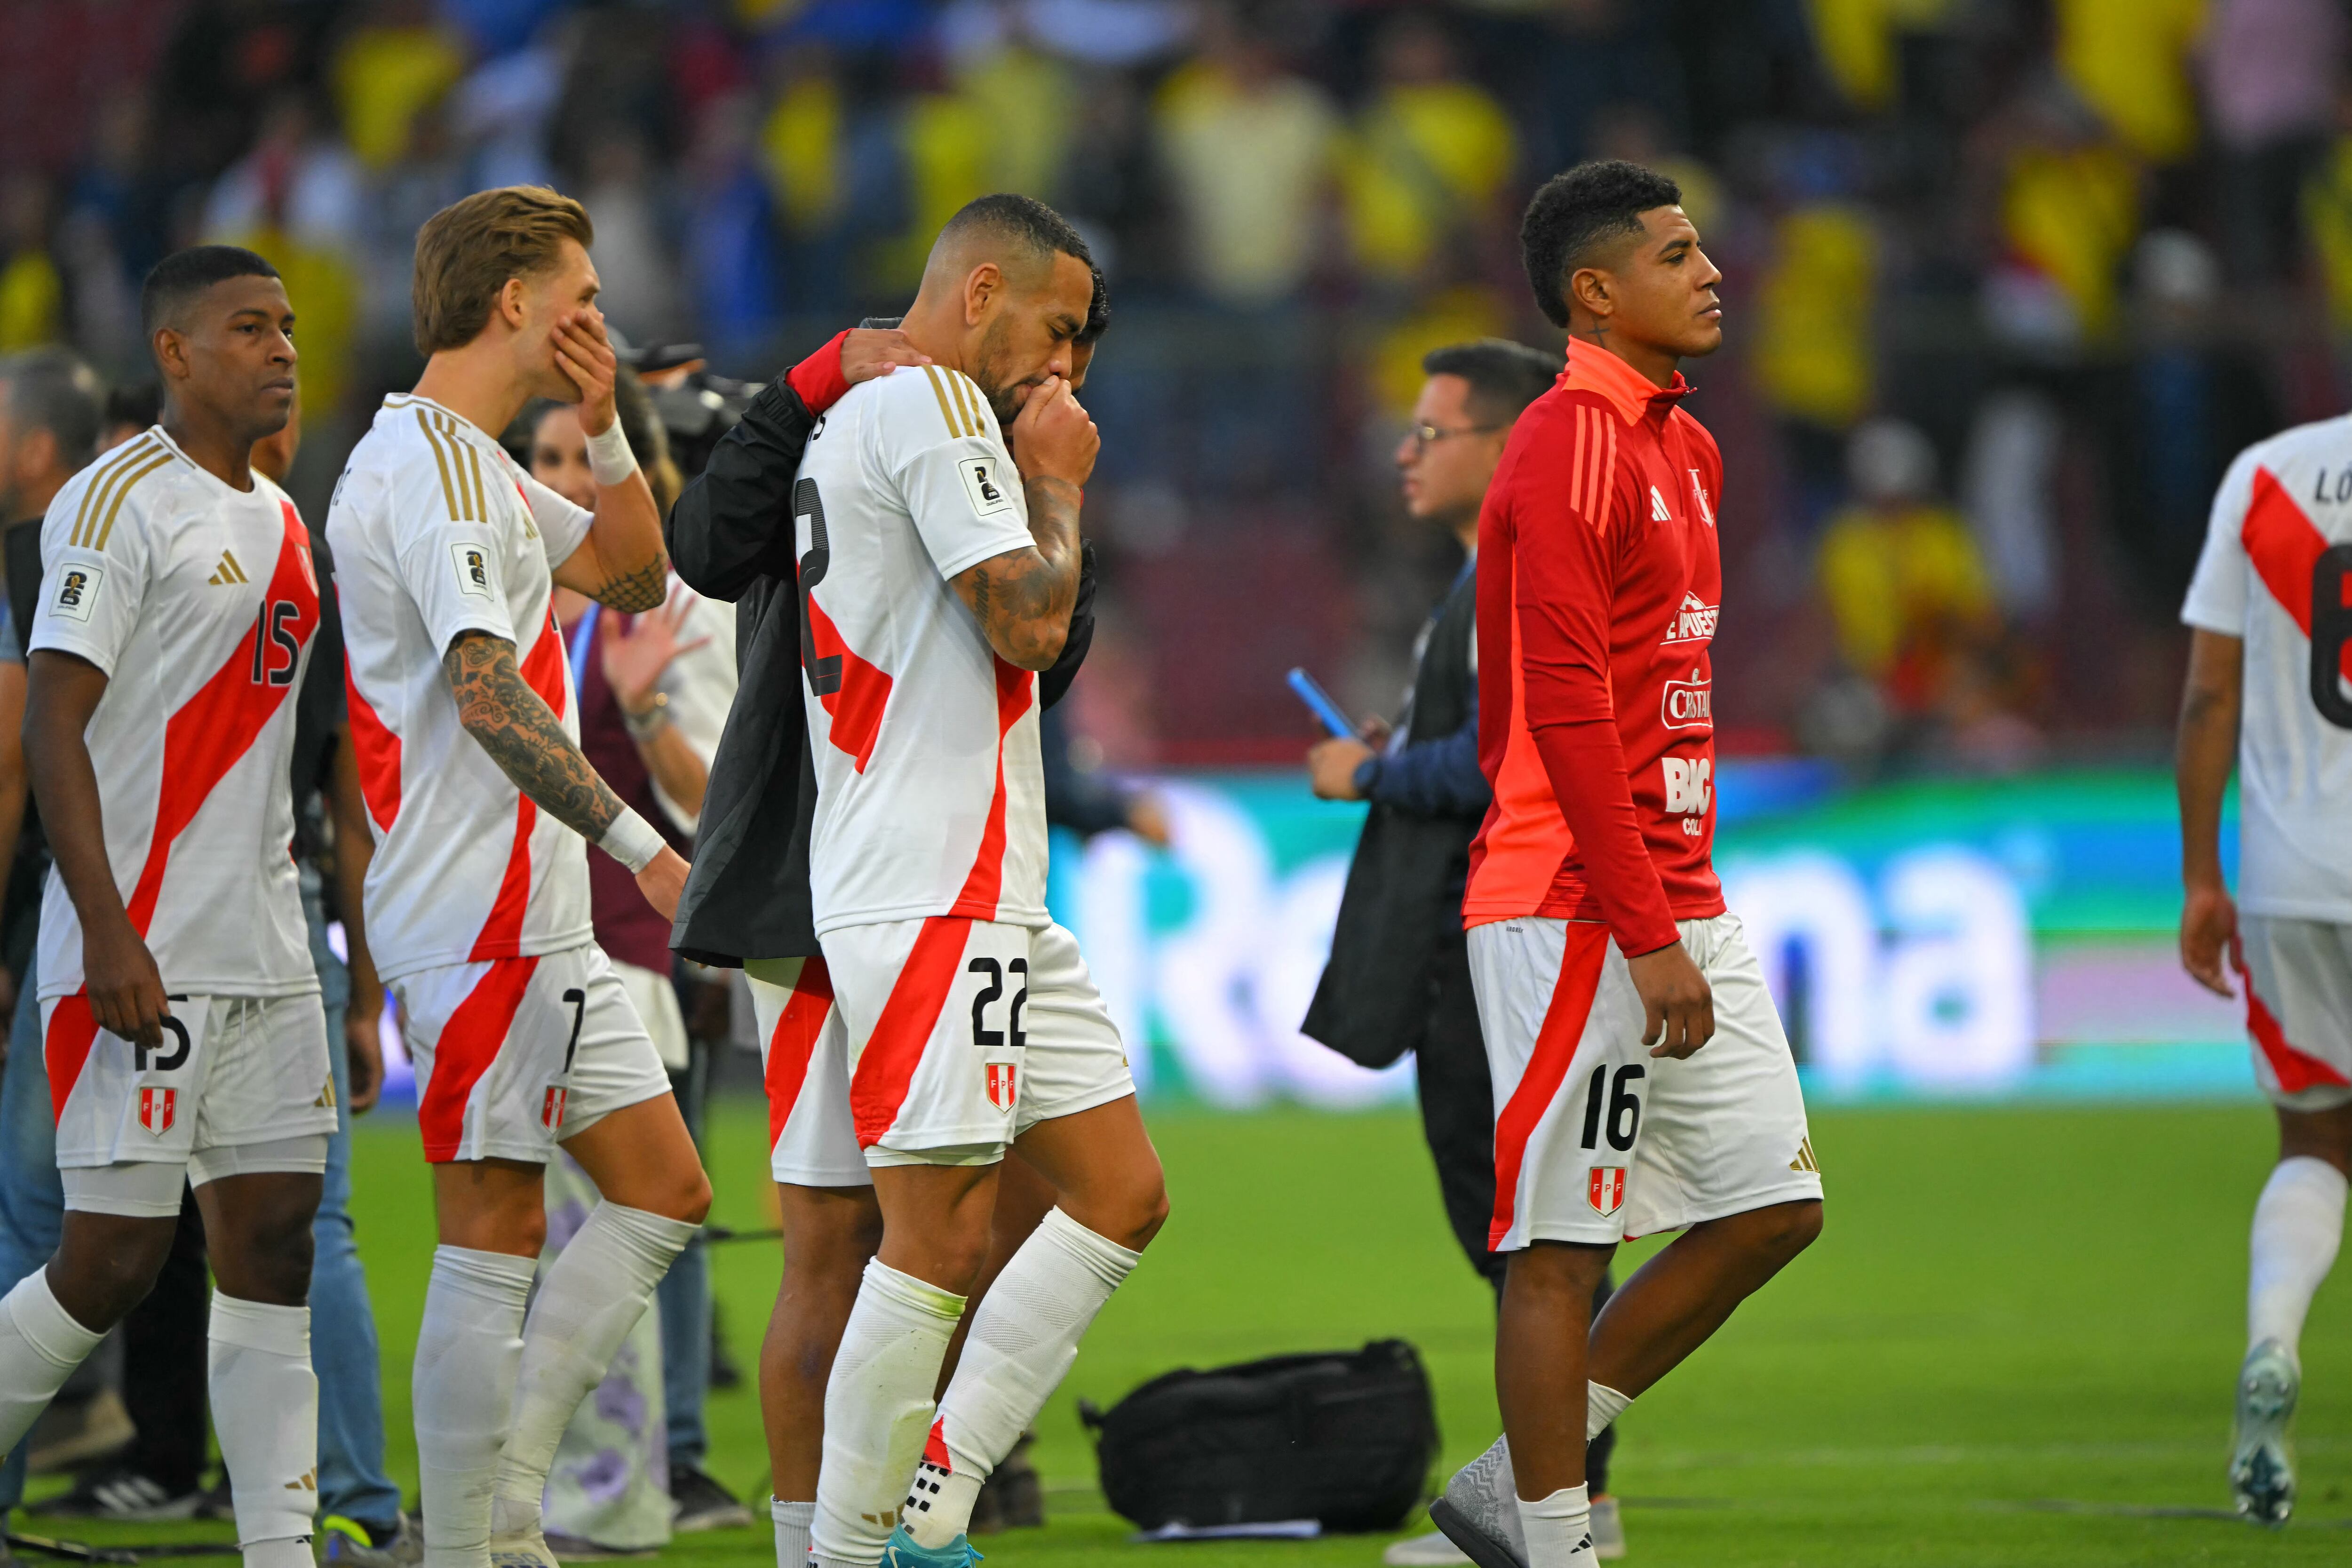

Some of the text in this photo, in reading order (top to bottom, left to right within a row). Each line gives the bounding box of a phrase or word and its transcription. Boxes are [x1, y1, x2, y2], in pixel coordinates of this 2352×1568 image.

[251, 599, 300, 686] 15
[1661, 757, 1711, 815] BIG
[562, 988, 585, 1074] 7
[968, 957, 1028, 1046] 22
[1581, 1064, 1645, 1152] 16
[1593, 1183, 1622, 1192] FPF
